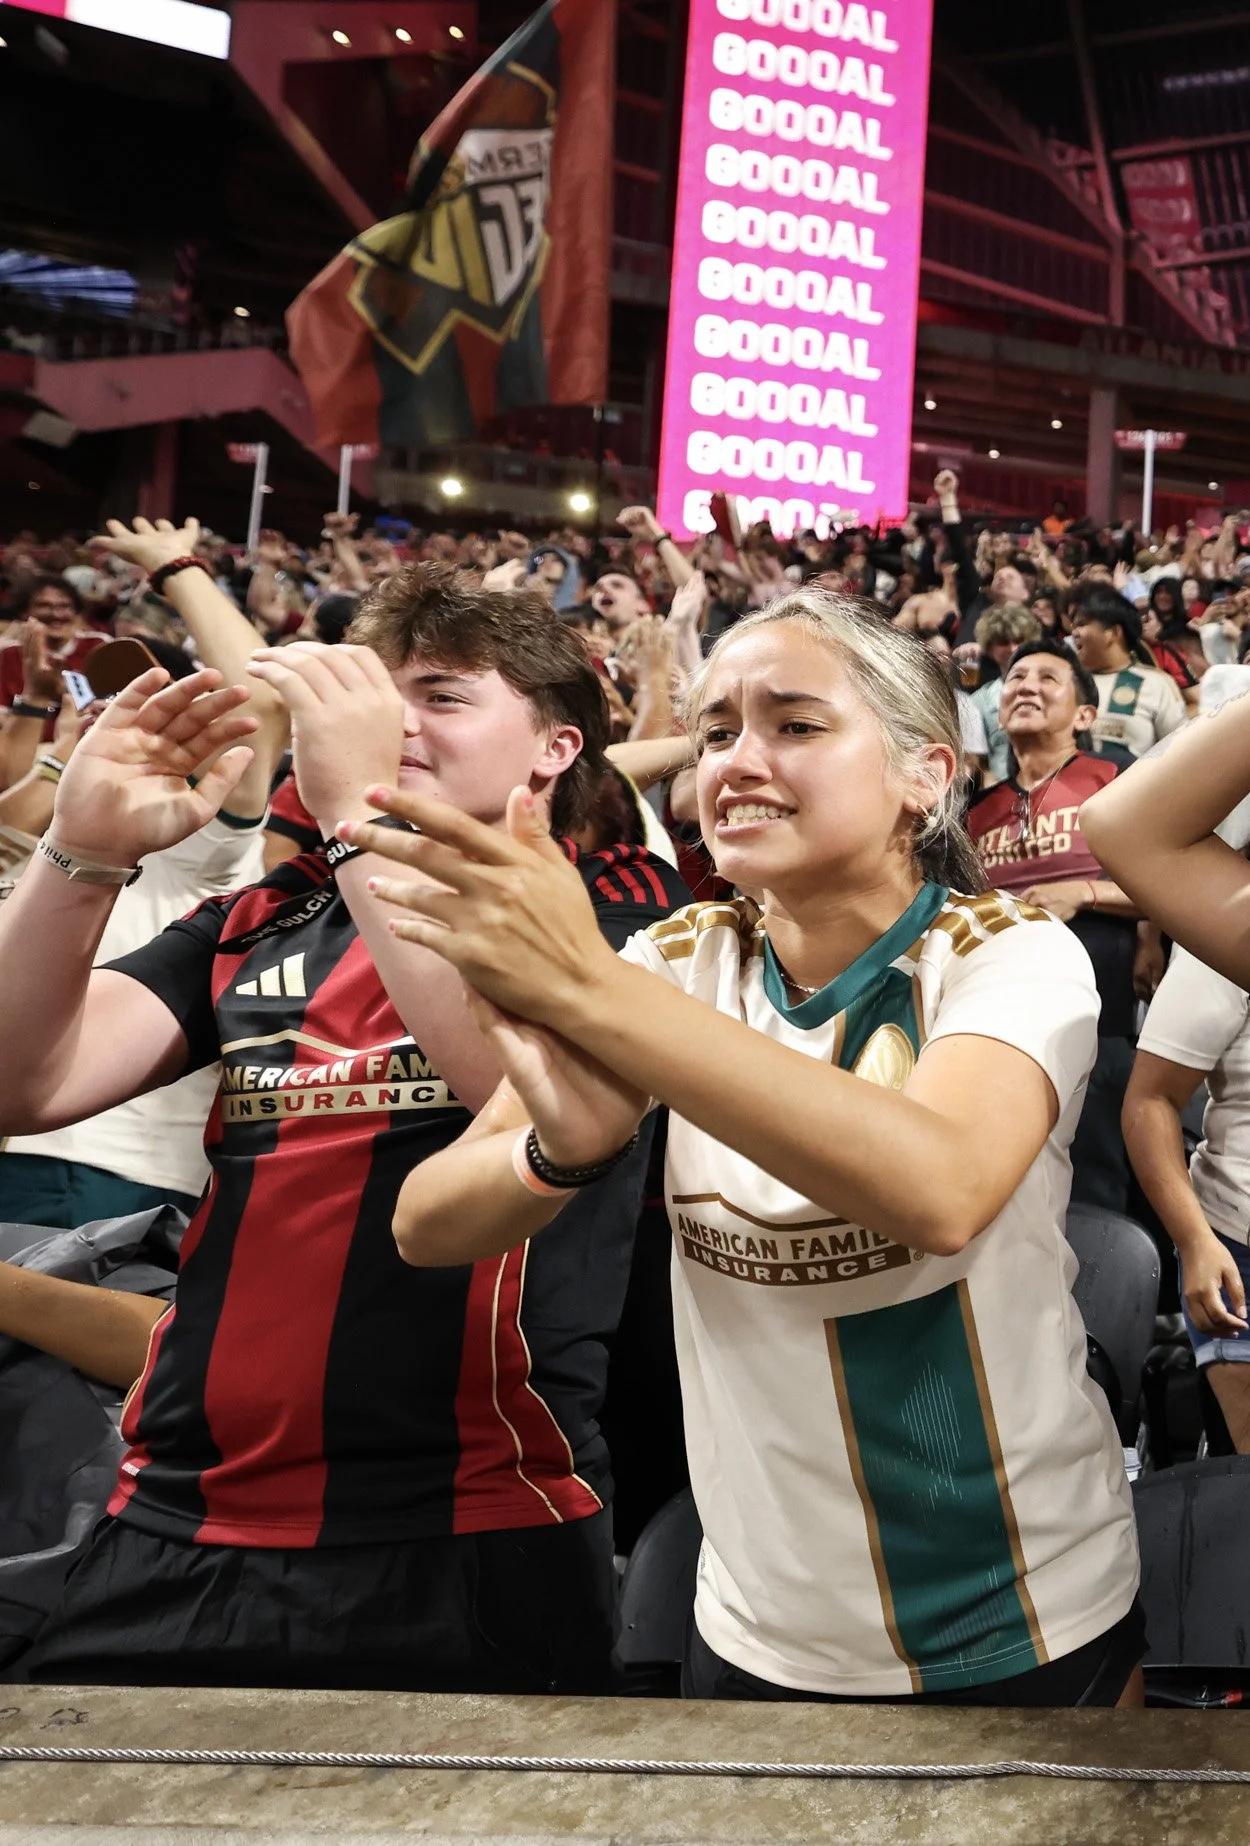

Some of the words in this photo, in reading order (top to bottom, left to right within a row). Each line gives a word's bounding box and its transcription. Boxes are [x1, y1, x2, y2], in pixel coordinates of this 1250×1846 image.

[712, 32, 896, 107] GOOOAL
[709, 88, 894, 160] GOOOAL
[705, 144, 891, 214] GOOOAL
[702, 200, 887, 270] GOOOAL
[698, 257, 885, 325] GOOOAL
[694, 314, 882, 381] GOOOAL
[690, 372, 879, 437] GOOOAL
[686, 430, 876, 494] GOOOAL
[326, 842, 360, 865] GUL
[276, 890, 334, 928] GULCH
[366, 1053, 443, 1082] FAM
[677, 1213, 779, 1260] AMERICAN
[790, 1228, 890, 1260] FAMIL
[693, 1245, 888, 1282] INSURANCE
